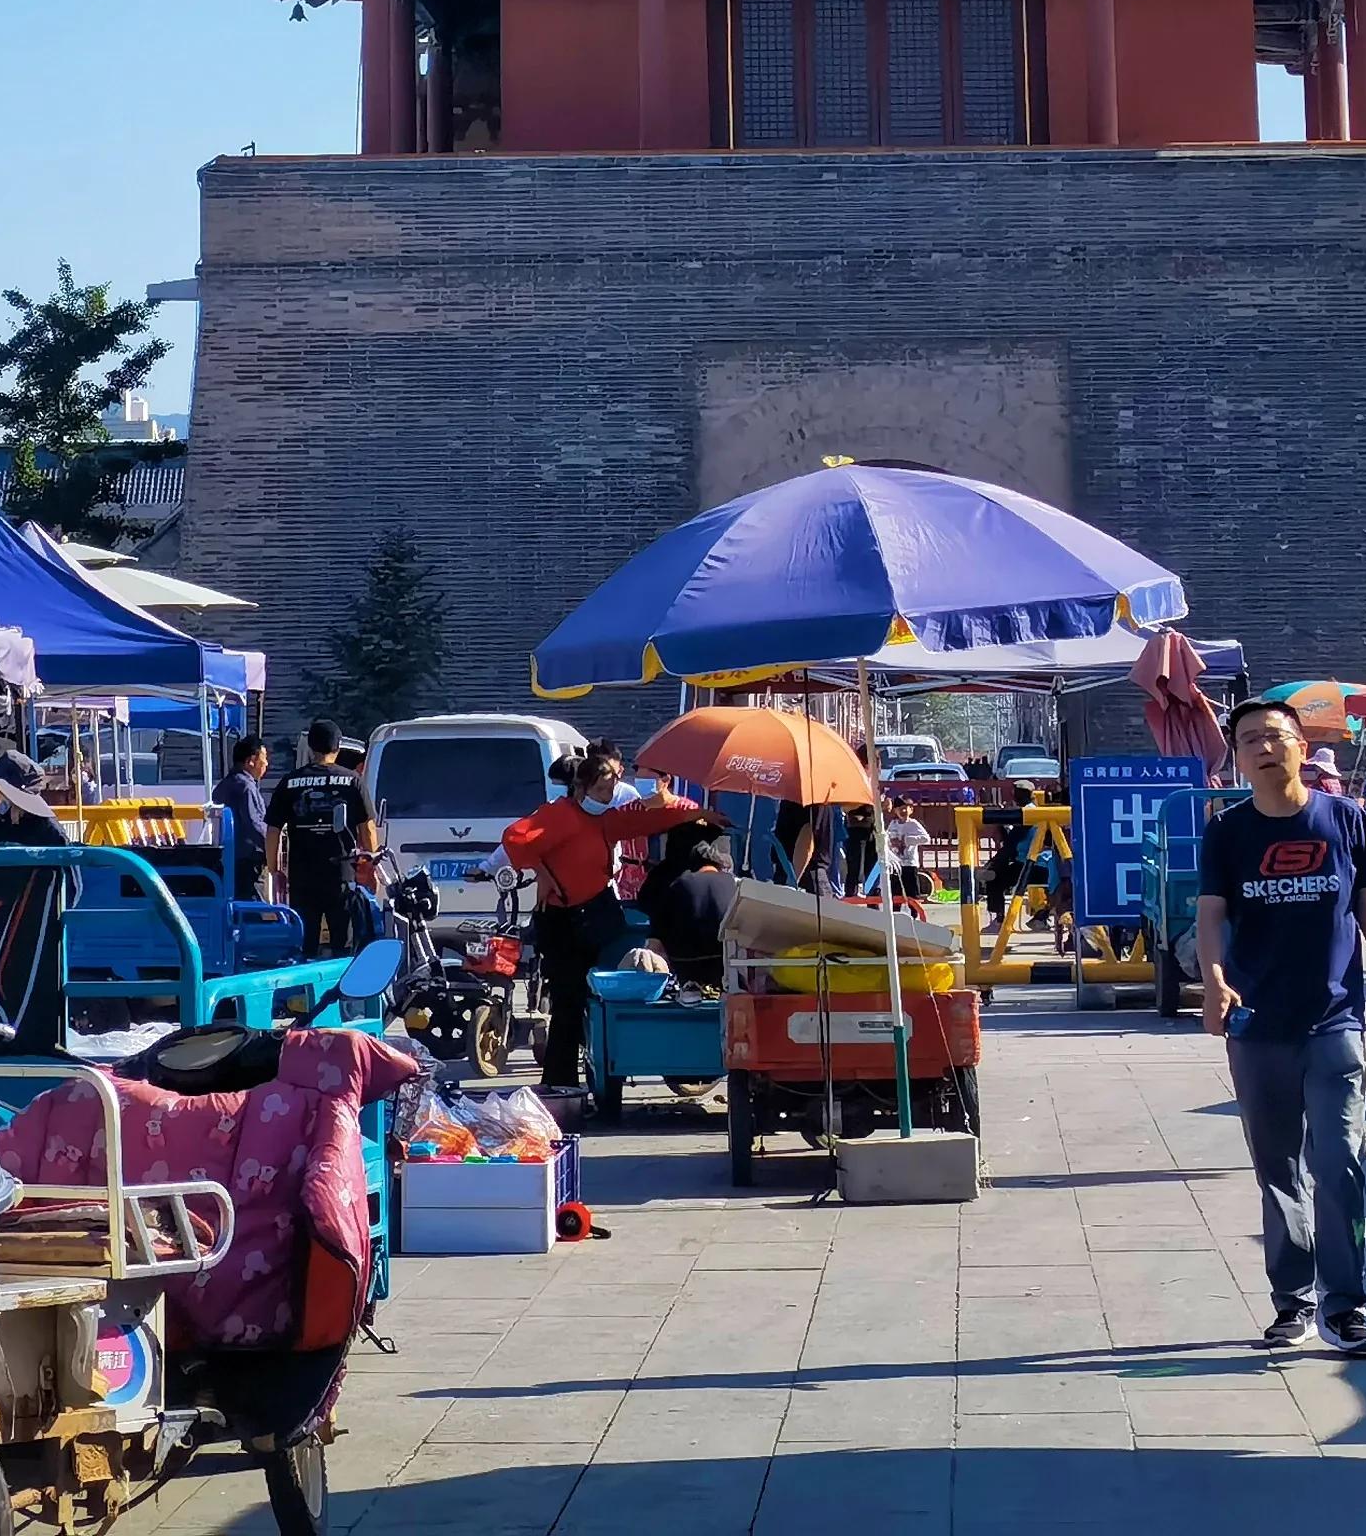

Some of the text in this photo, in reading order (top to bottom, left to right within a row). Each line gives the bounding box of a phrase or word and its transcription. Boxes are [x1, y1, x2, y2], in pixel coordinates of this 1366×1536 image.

[1242, 874, 1341, 899] SKECHERS
[1265, 893, 1321, 904] LOS ANGELES
